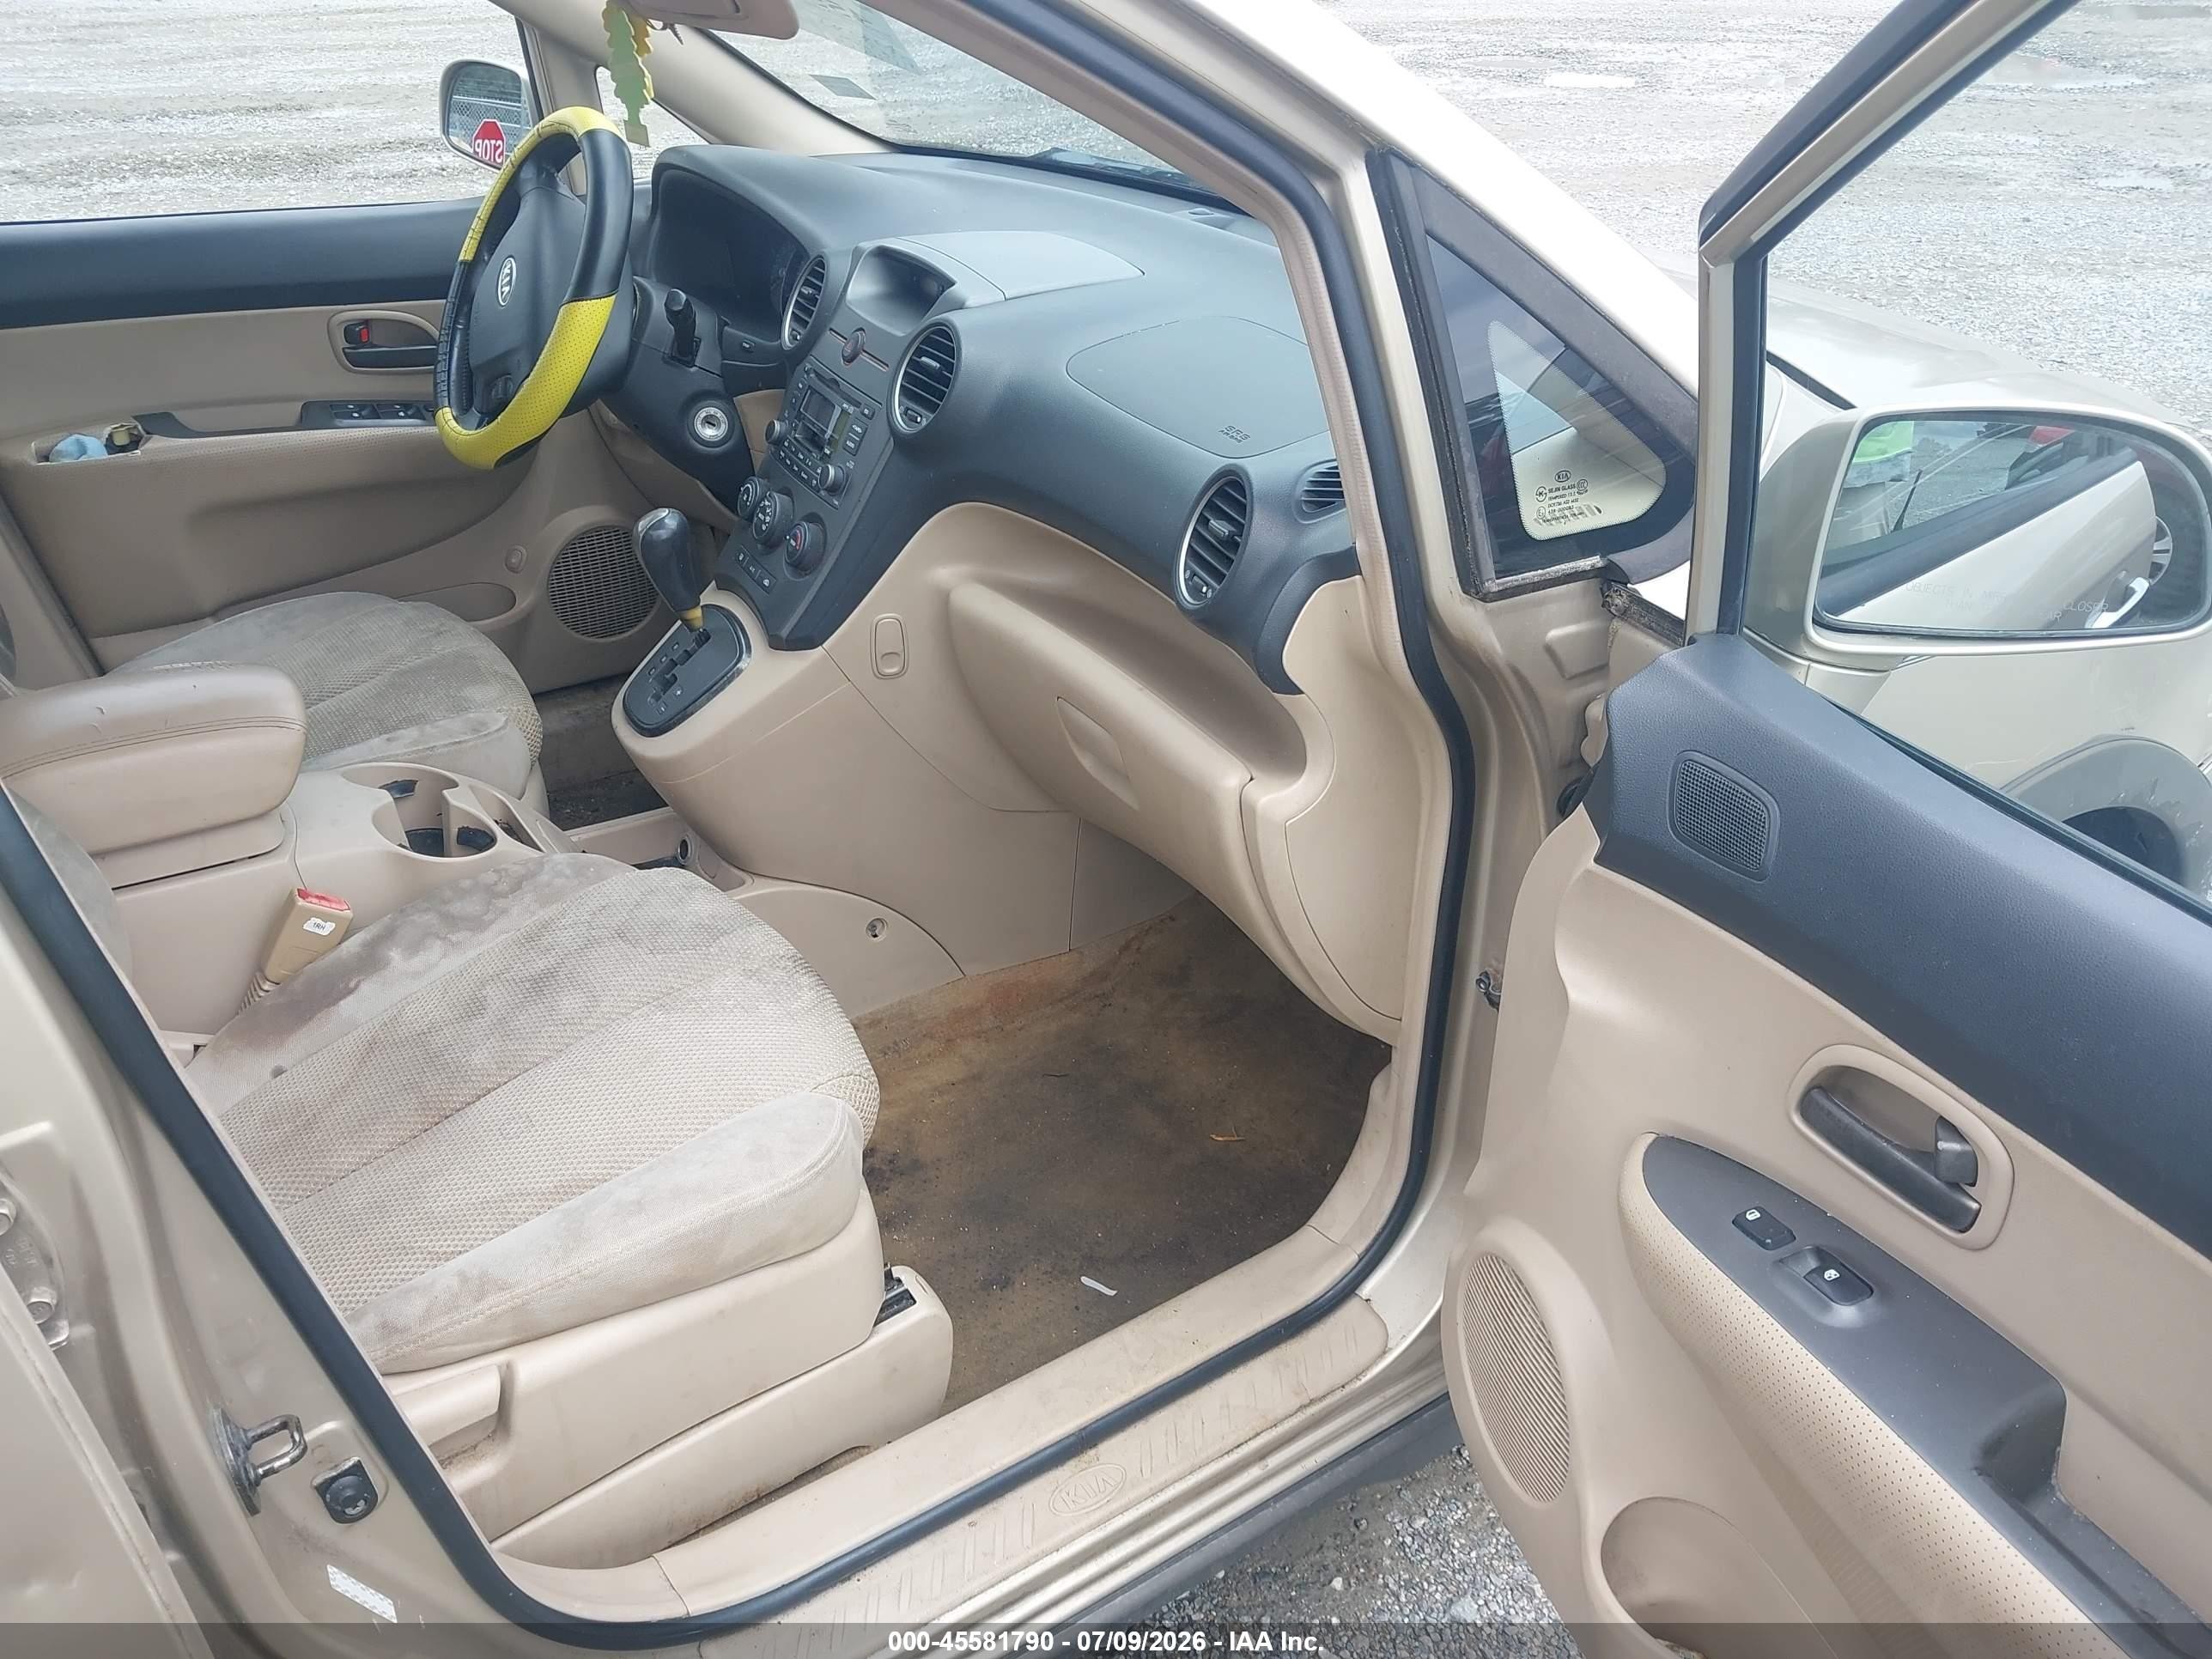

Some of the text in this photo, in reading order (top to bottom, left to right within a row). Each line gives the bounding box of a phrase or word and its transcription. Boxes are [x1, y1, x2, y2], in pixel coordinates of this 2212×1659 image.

[500, 260, 513, 301] KIA
[1556, 471, 1569, 481] KIA
[1905, 582, 1955, 598] OBJECTS
[2063, 600, 2109, 613] CLOSER
[1058, 1473, 1118, 1512] KIA
